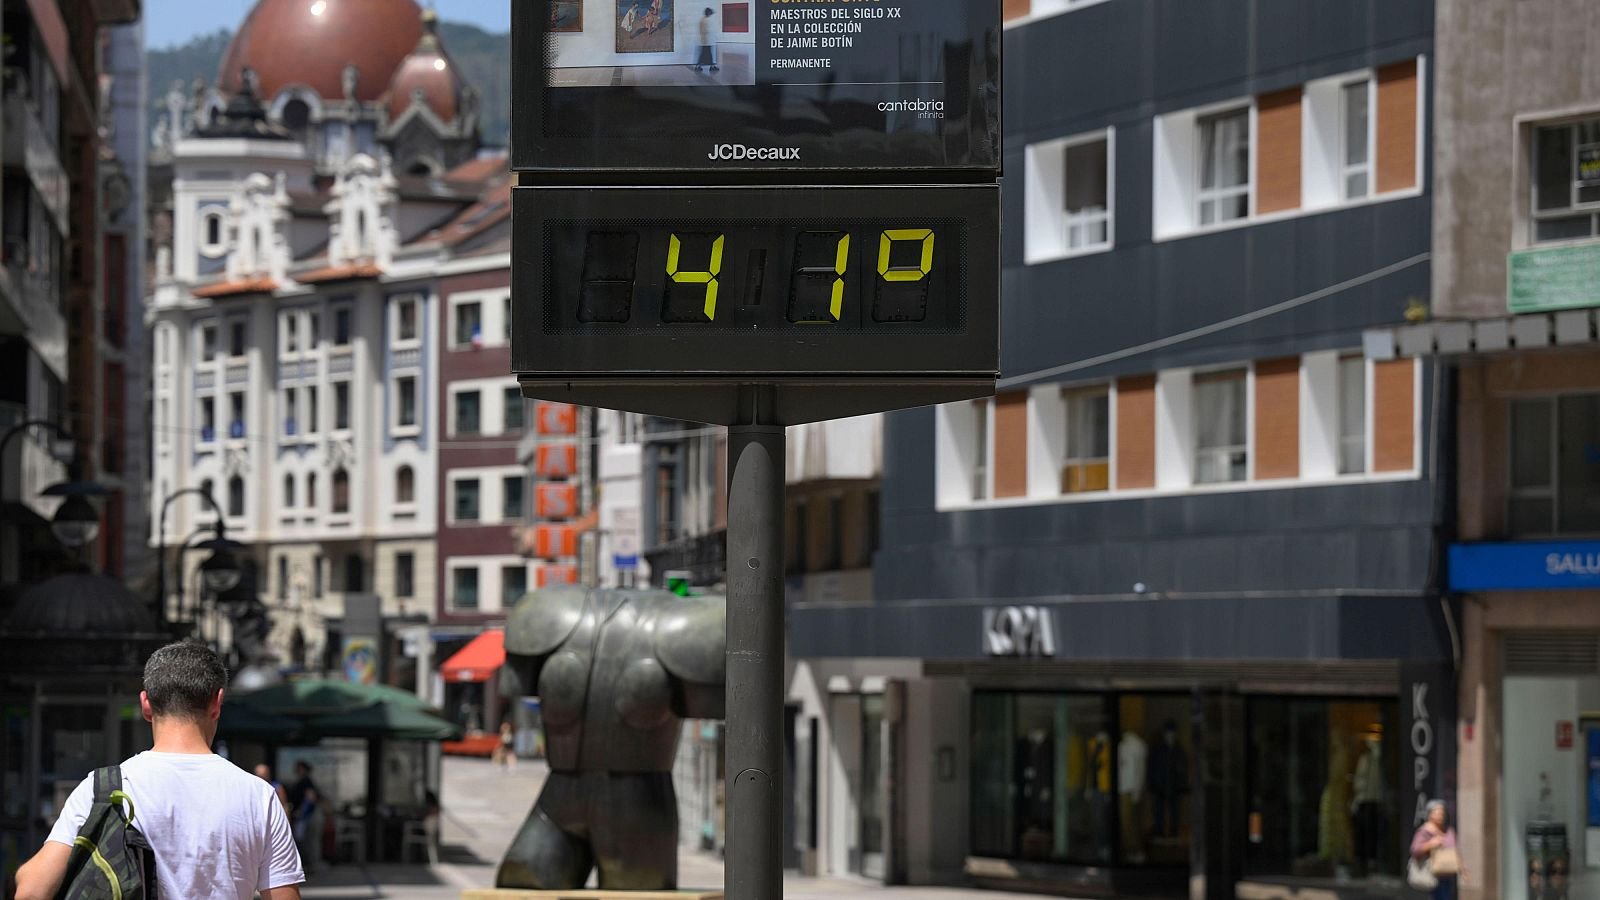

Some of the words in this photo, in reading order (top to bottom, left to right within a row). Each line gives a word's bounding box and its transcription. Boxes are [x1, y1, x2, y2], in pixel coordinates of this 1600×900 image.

[770, 9, 828, 20] MAESTROS
[831, 8, 850, 19] DEL
[853, 8, 884, 19] SIGLO
[886, 7, 901, 18] XX
[770, 23, 784, 34] EN
[788, 23, 801, 34] LA
[804, 21, 862, 34] COLECCIÓN
[770, 38, 784, 48] DE
[787, 37, 818, 48] JAIME
[821, 35, 853, 48] BOTÍN
[770, 59, 831, 68] PERMANENTE
[877, 98, 944, 112] cantabria
[917, 111, 944, 119] infinita
[708, 144, 801, 160] JCDecaux
